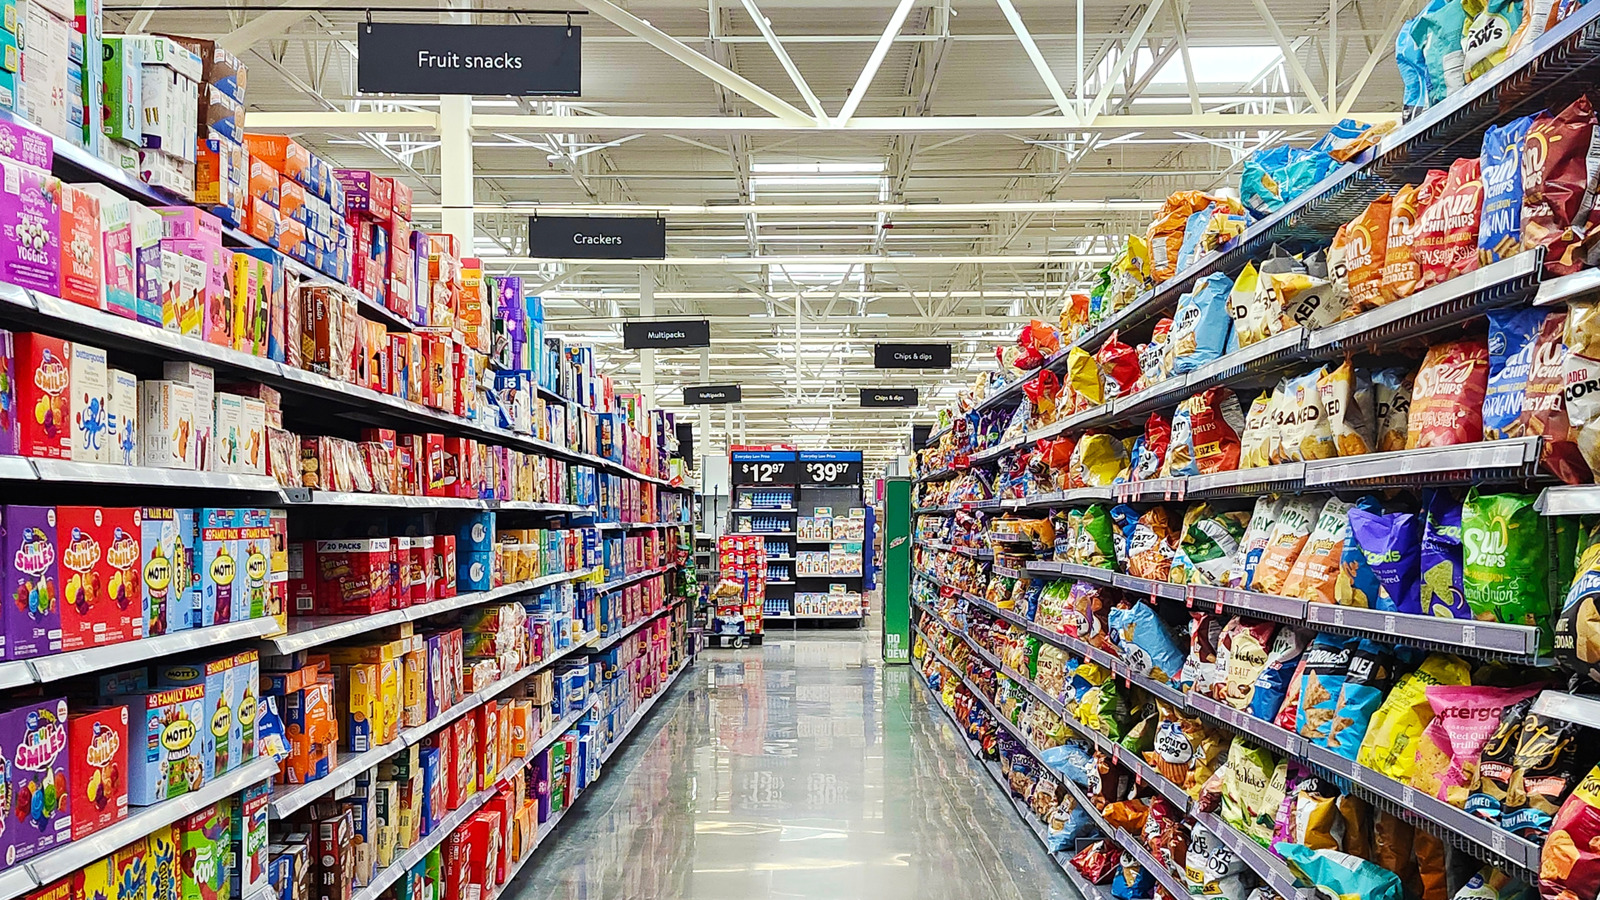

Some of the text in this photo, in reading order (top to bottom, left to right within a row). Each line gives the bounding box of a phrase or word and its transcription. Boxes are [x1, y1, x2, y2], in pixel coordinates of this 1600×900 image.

[418, 51, 522, 69] Fruit snacks
[1482, 146, 1518, 197] Sun
[1488, 180, 1514, 198] CHIPS
[1447, 213, 1475, 229] CHIPS
[573, 233, 622, 246] Crackers
[1389, 234, 1413, 248] HIPS
[17, 245, 49, 267] YOGGIES
[1293, 295, 1321, 326] KED
[647, 331, 685, 341] Multipacks
[75, 349, 105, 364] bettergoods
[894, 353, 912, 362] Chips
[919, 353, 933, 362] dips
[1502, 364, 1530, 379] CHIP
[1537, 364, 1563, 379] CHIP
[1567, 369, 1588, 385] ADED
[35, 369, 69, 392] SMILES
[1437, 383, 1463, 396] CHIPS
[1566, 380, 1600, 403] COR
[1324, 399, 1339, 418] KED
[1483, 393, 1525, 417] ORIGINA
[1277, 405, 1319, 426] BAKED
[1279, 510, 1309, 530] MPLY
[1318, 514, 1346, 535] MPLY
[212, 529, 239, 540] FAMILY PACK
[246, 528, 270, 539] FAMILY PACK
[1464, 518, 1508, 565] Sun
[24, 541, 47, 555] FRUIT
[73, 539, 92, 552] FRUIT
[115, 540, 132, 552] FRUIT
[16, 543, 54, 571] SMILES
[65, 542, 101, 570] SMILES
[108, 541, 140, 569] SMILES
[148, 564, 170, 580] MOTT'S
[213, 563, 234, 576] MOTT'S
[1482, 584, 1514, 603] Onion
[887, 634, 900, 643] DO
[887, 649, 908, 658] DEW
[168, 670, 195, 679] MOTT'S
[1234, 667, 1250, 678] SALT
[158, 690, 183, 706] FAMILY
[185, 685, 205, 699] PACK
[28, 724, 55, 746] FRUIT
[94, 731, 112, 748] FRUIT
[166, 725, 194, 744] MOTT'S
[1450, 731, 1492, 742] Red Qui
[17, 730, 65, 769] SMILES
[88, 736, 119, 765] SMILES
[1159, 736, 1188, 750] POTATO
[1451, 741, 1479, 749] ortilla
[168, 746, 191, 761] ANIMALS
[453, 832, 460, 843] 30
[1215, 848, 1231, 864] PE
[1208, 856, 1229, 875] OD
[1187, 869, 1200, 881] SIZE
